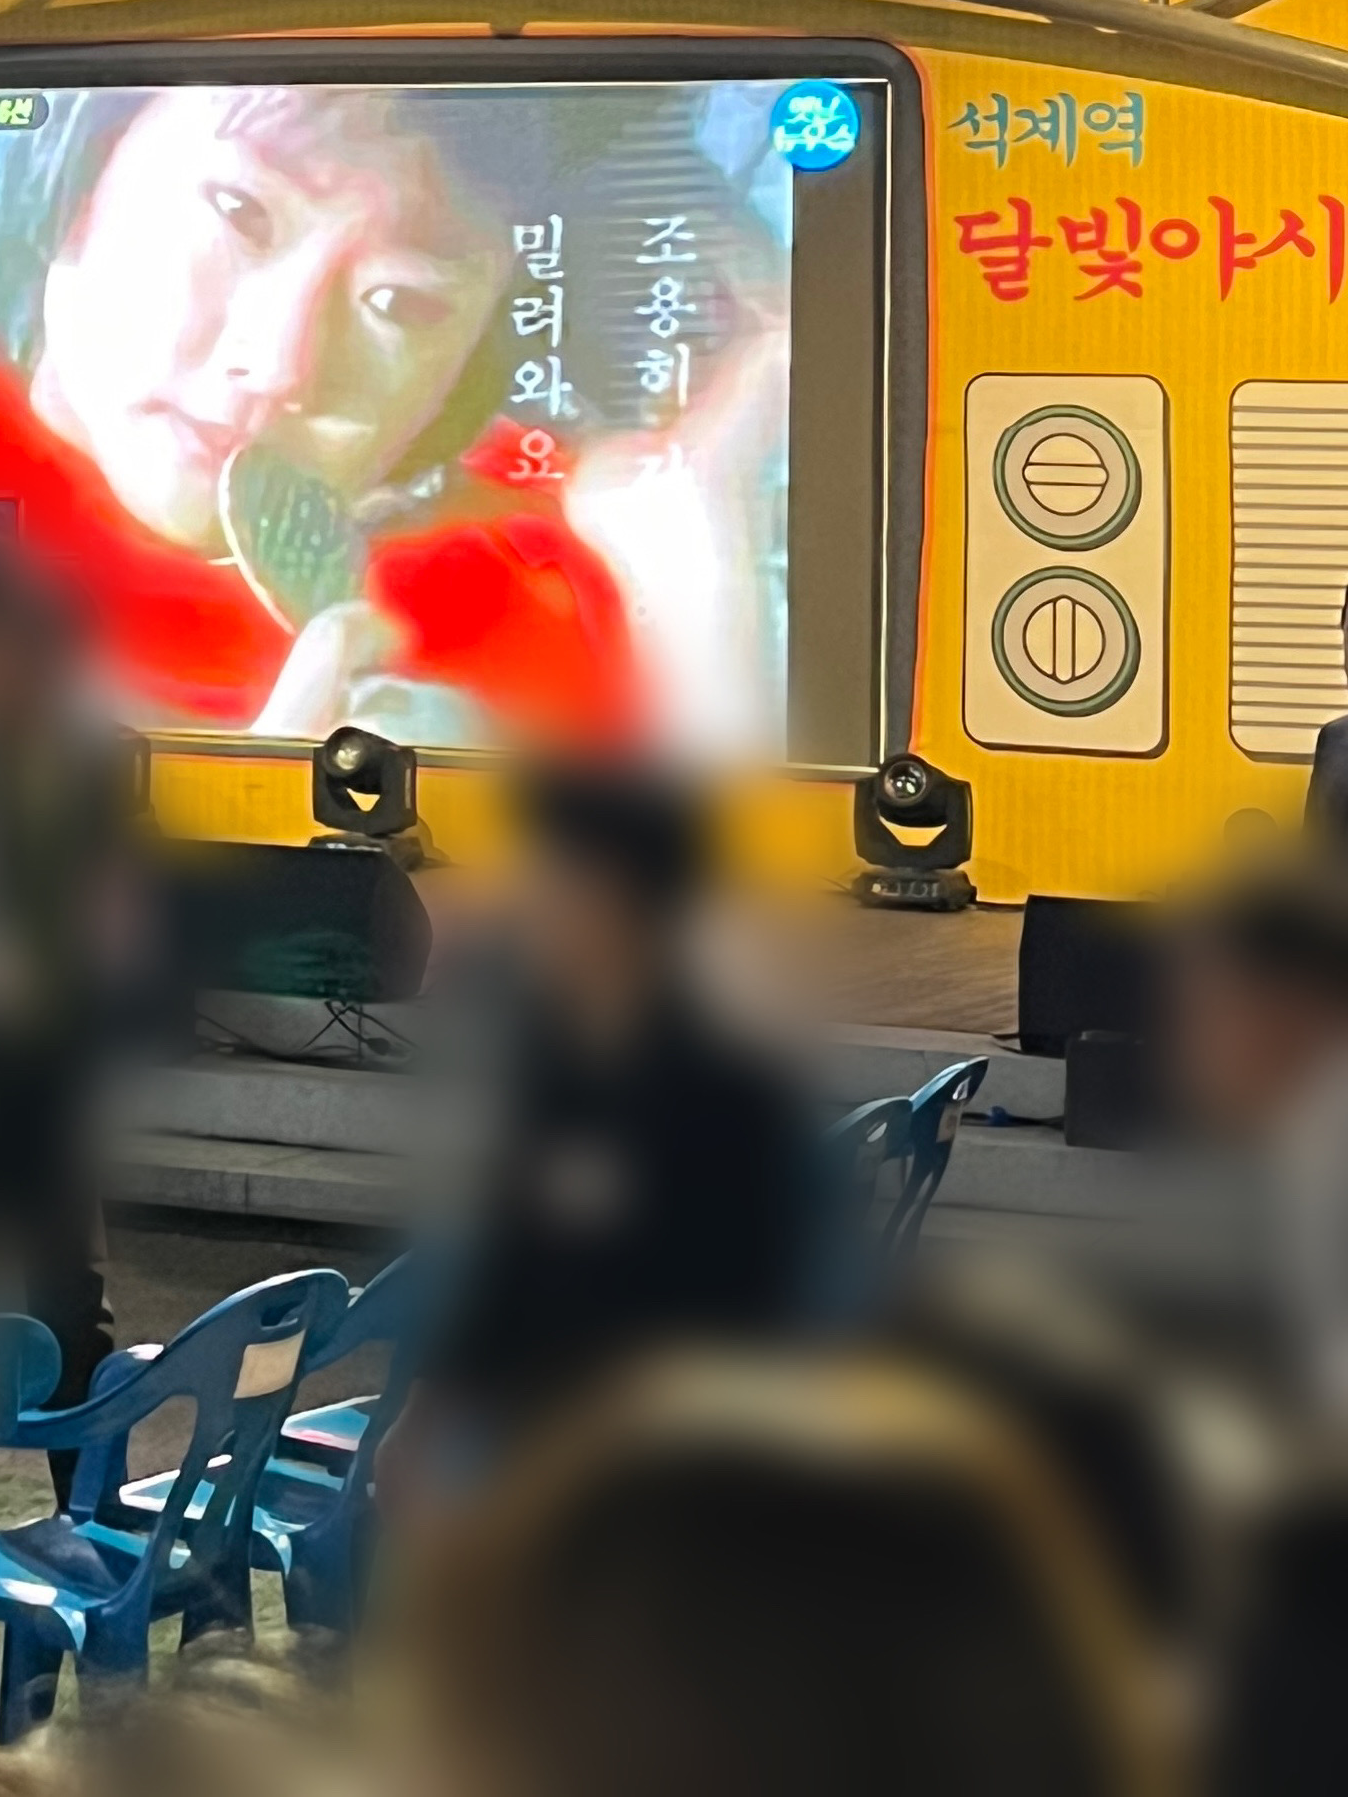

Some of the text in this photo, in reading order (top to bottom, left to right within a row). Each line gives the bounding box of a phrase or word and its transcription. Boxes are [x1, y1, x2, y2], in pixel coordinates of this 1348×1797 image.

[948, 91, 1144, 169] 석계역
[635, 215, 697, 407] 조용히
[954, 194, 1346, 304] 달빛야시
[507, 213, 573, 479] 밀려와요
